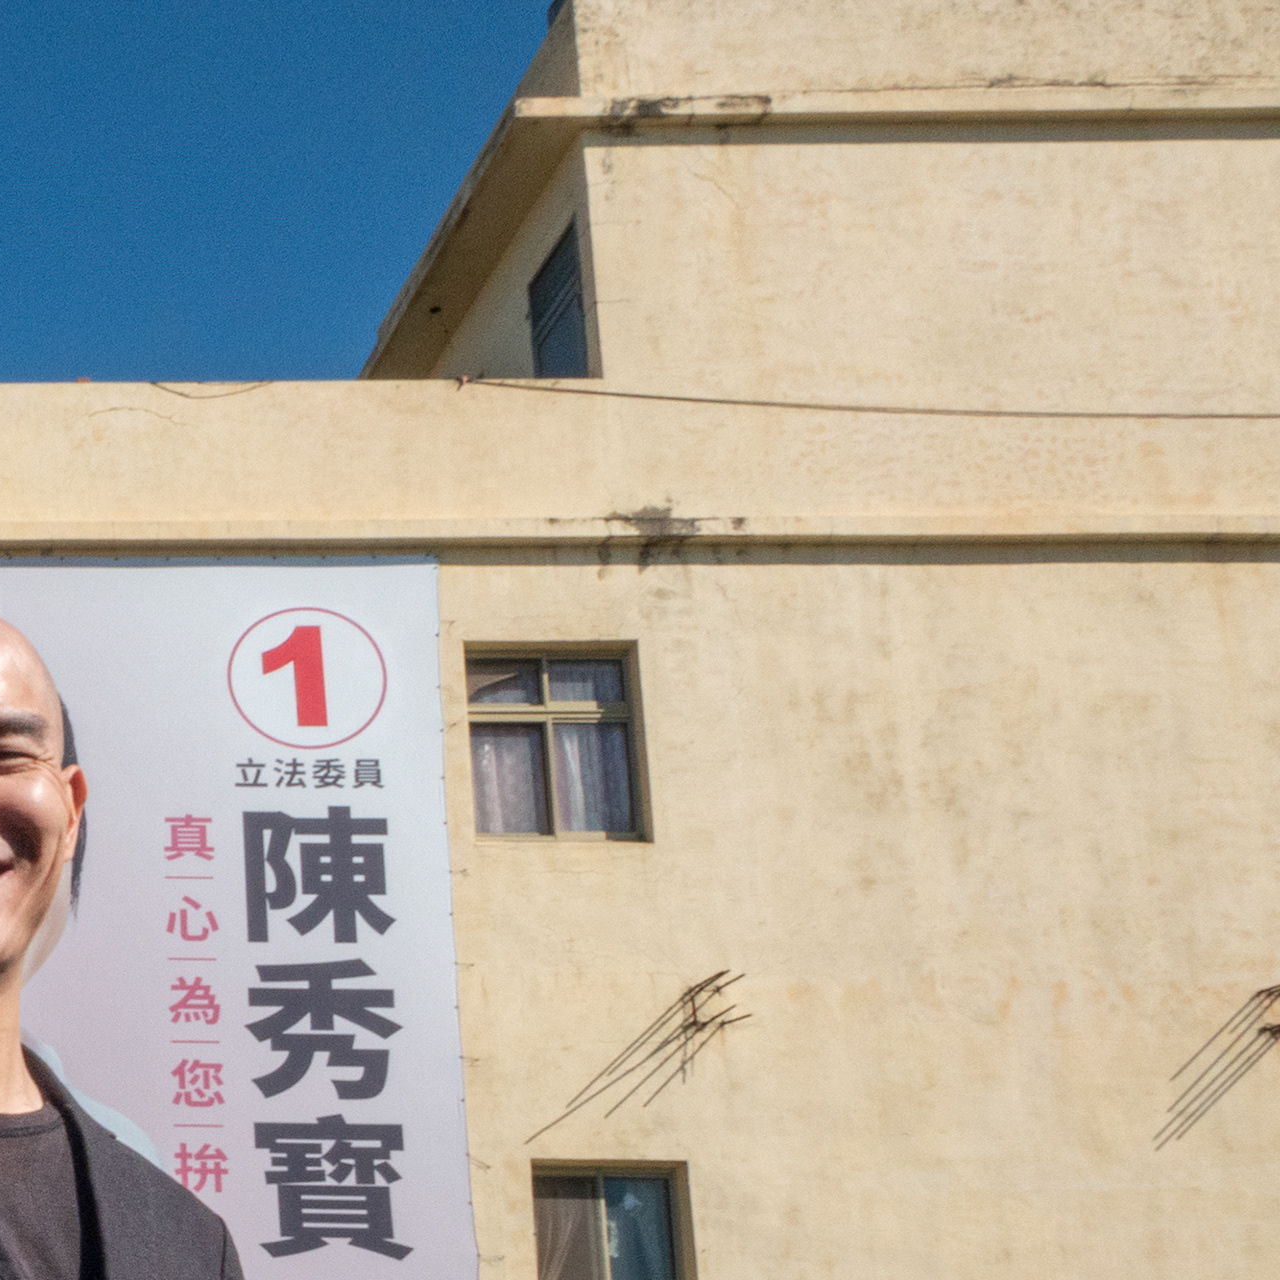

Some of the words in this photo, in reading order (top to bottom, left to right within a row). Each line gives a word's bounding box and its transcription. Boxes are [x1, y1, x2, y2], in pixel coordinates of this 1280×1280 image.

[261, 625, 328, 727] 1
[235, 757, 385, 789] 立法委員
[243, 806, 414, 1261] 陳秀寶
